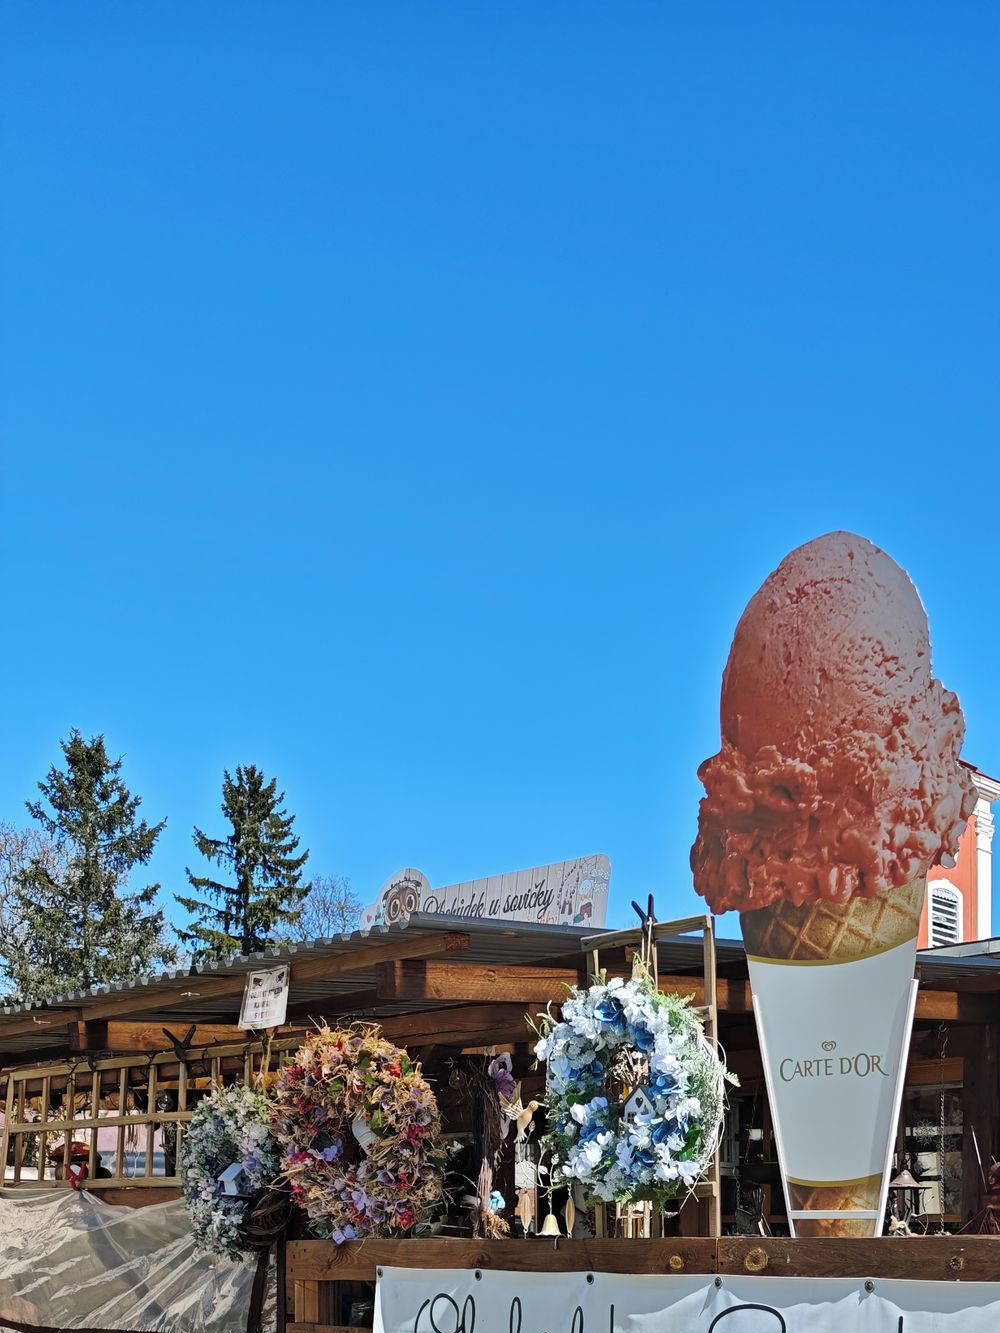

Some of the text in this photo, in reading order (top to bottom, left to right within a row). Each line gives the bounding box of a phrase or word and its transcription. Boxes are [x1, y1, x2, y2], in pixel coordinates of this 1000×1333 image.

[488, 898, 501, 917] u
[503, 879, 555, 920] sovičky
[780, 1053, 890, 1082] CARTE D'OR
